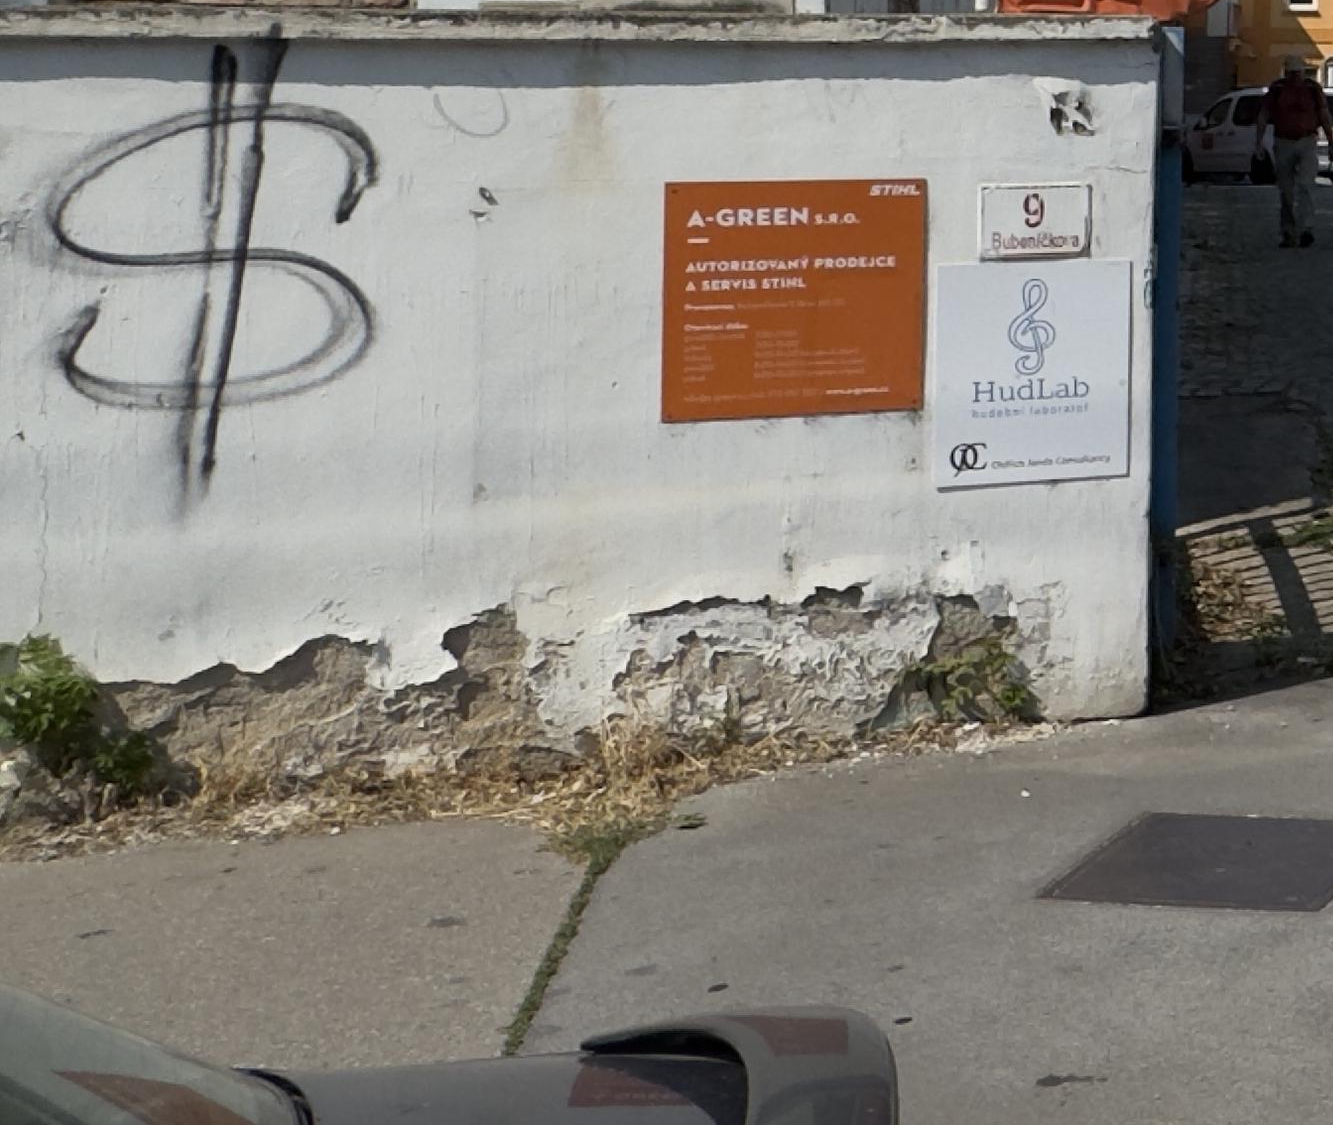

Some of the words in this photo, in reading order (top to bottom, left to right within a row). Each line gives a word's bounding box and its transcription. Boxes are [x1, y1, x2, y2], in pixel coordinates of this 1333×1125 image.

[869, 184, 921, 197] STIHL
[686, 207, 810, 228] A-GREEN
[1023, 192, 1045, 228] 9
[685, 254, 809, 273] AUTORIZOVANÝ
[813, 256, 896, 270] PRODEJCE
[685, 281, 697, 291] A
[701, 279, 758, 291] SERVIS
[762, 277, 807, 290] STIHL
[972, 375, 1090, 403] HudLab
